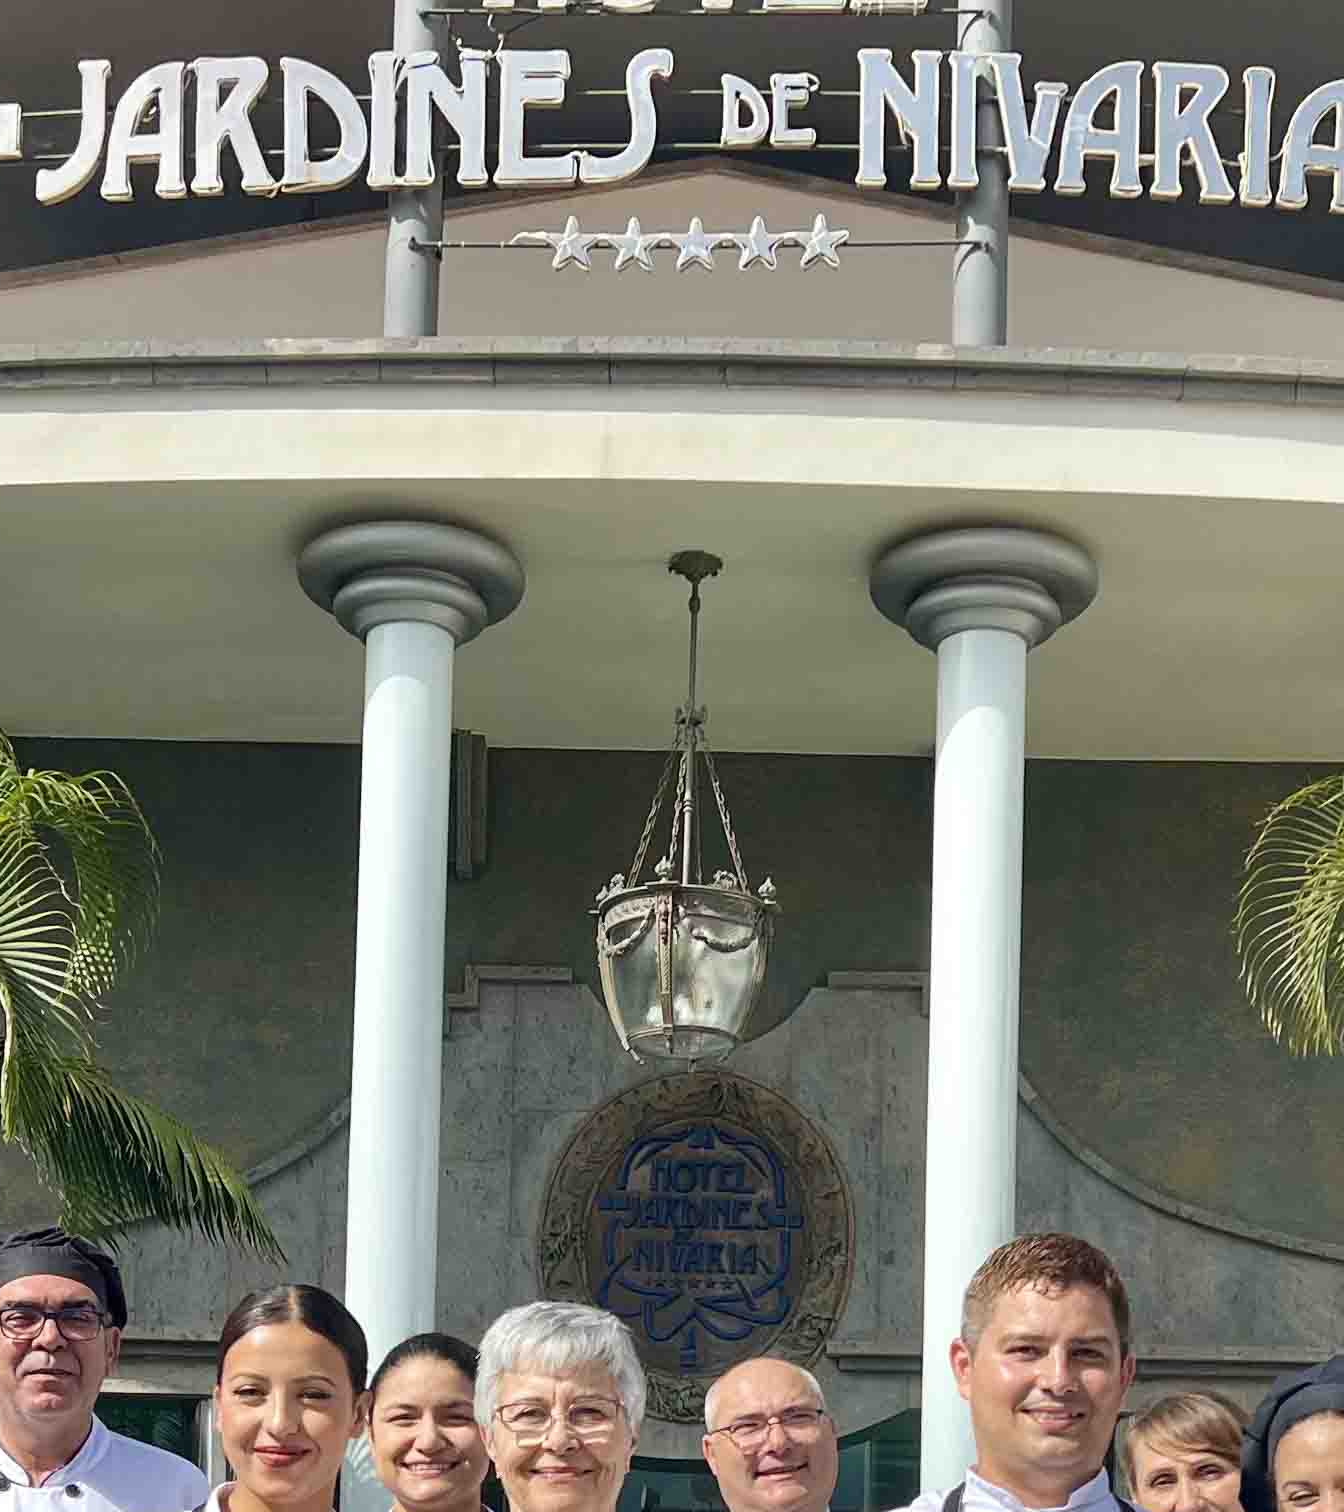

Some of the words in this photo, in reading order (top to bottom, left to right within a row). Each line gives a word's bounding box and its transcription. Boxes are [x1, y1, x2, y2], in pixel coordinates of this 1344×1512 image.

[36, 48, 674, 205] JARDINES
[721, 73, 819, 148] DE
[650, 1159, 752, 1193] HOTEL
[623, 1196, 770, 1230] JARDINES
[633, 1239, 758, 1275] NIVARIA
